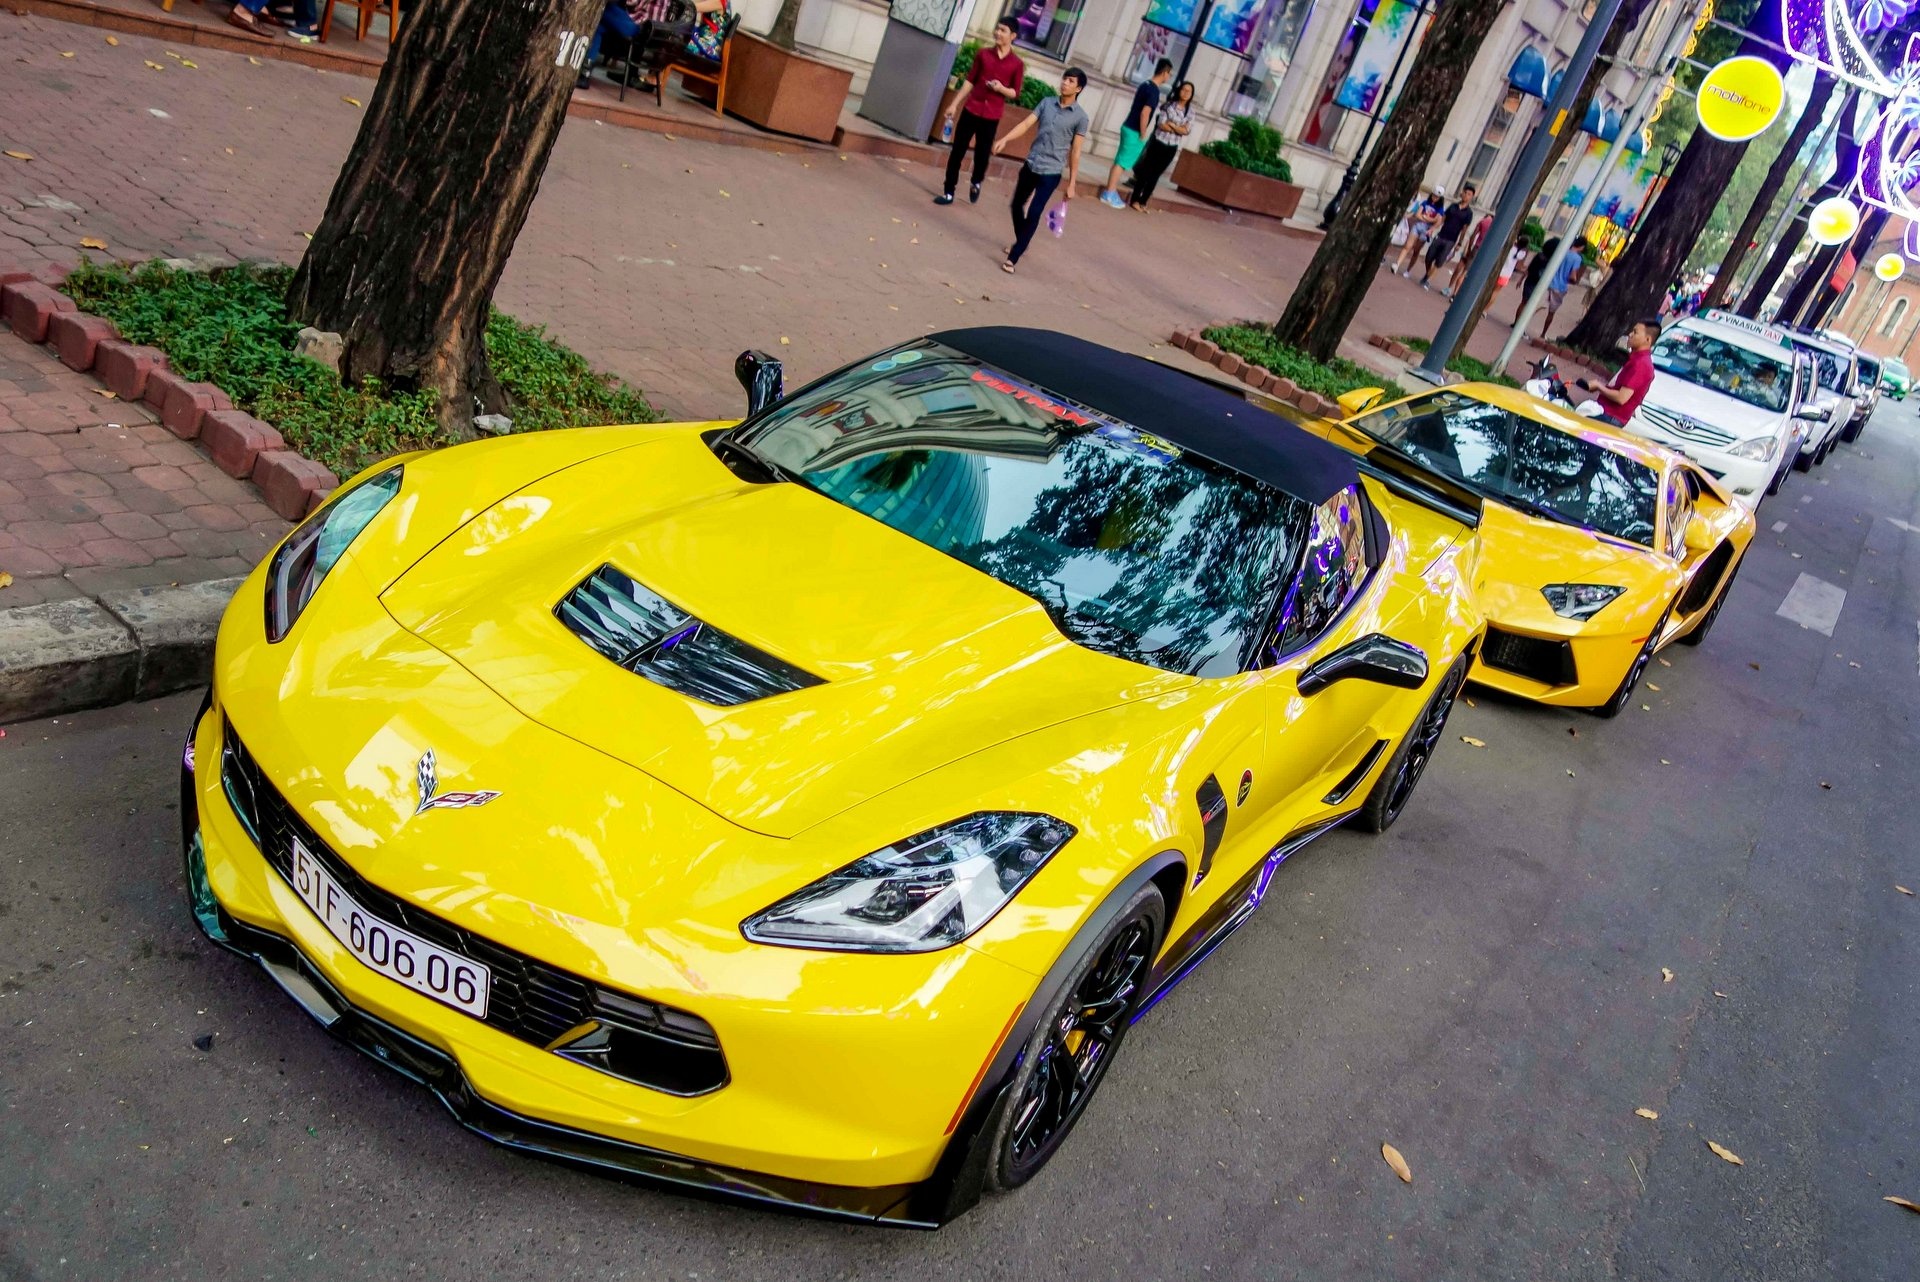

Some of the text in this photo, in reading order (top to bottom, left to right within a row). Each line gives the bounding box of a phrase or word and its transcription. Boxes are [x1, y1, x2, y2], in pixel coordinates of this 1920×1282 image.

[1706, 84, 1771, 115] mobifone
[1725, 315, 1781, 342] VINASUN TAXI
[971, 370, 1092, 427] VIETNAM
[297, 849, 478, 1005] 51F-606.06
